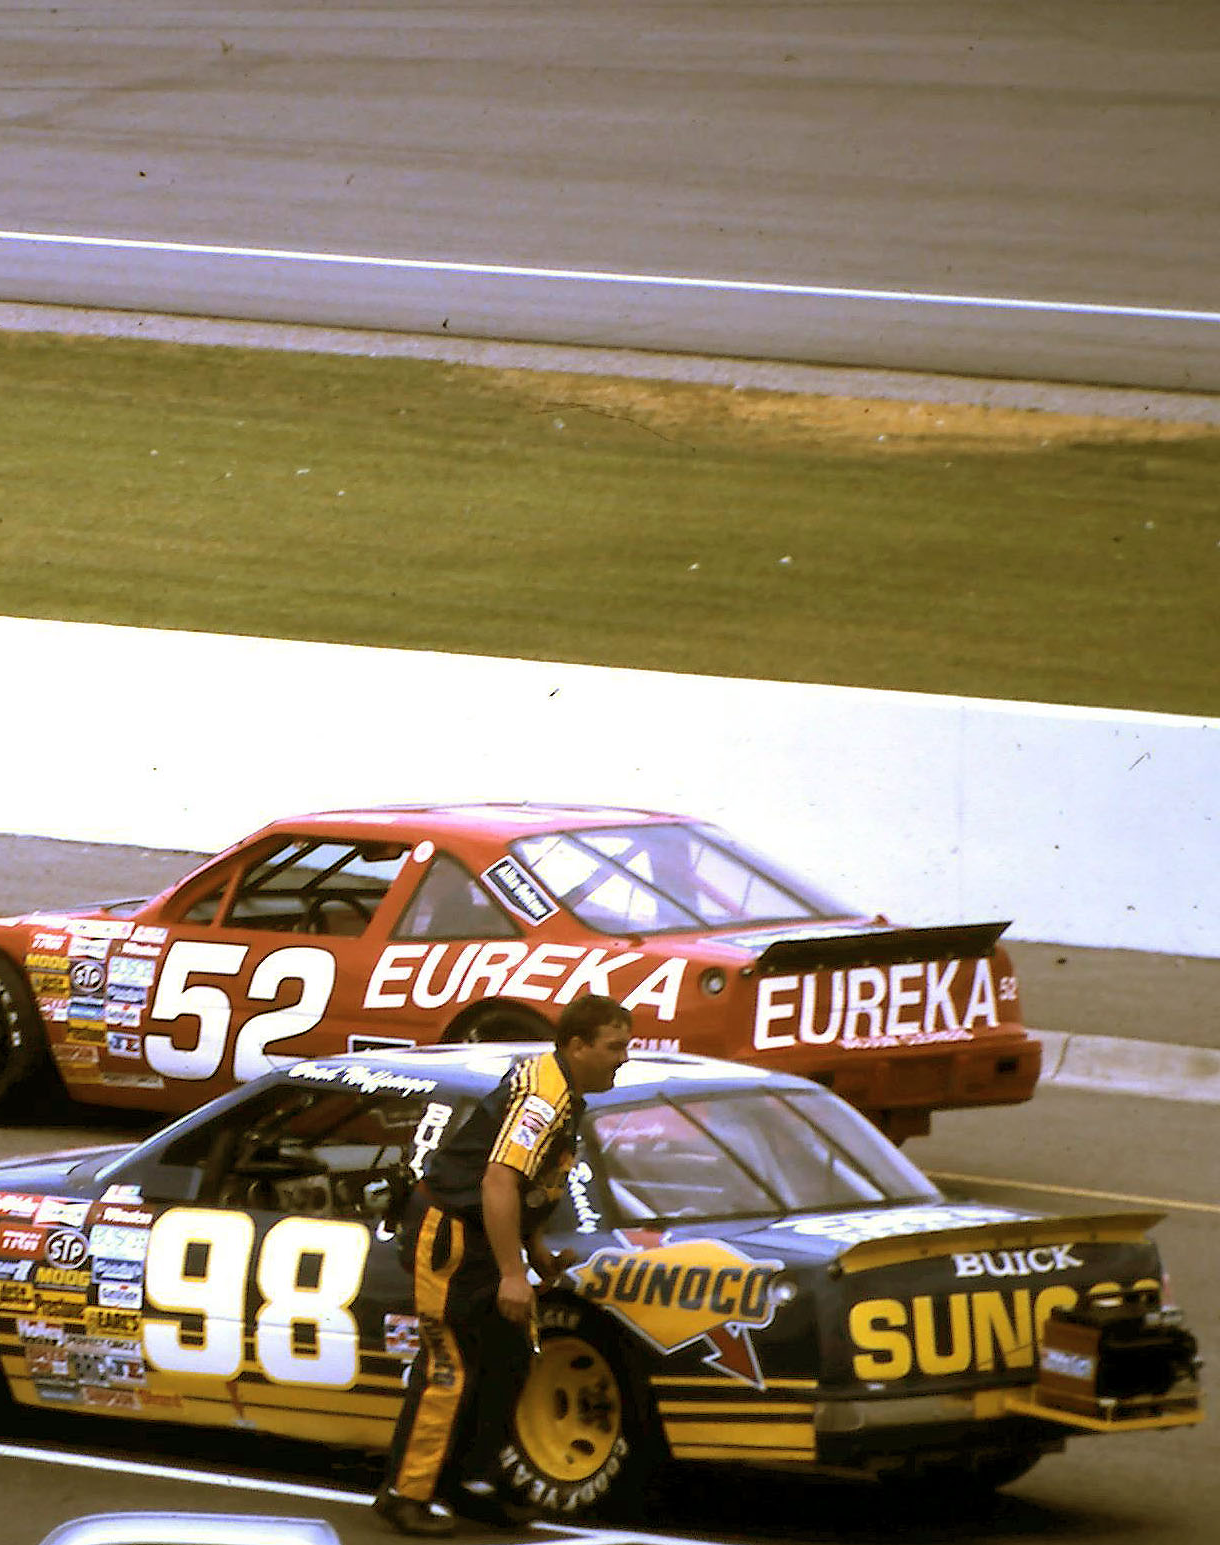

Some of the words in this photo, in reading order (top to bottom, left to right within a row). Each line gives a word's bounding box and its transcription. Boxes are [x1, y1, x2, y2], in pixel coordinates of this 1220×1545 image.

[143, 940, 336, 1085] 52
[363, 940, 688, 1022] EUREKA
[753, 957, 1001, 1051] EUREKA
[35, 1265, 92, 1287] MOOG
[49, 1234, 84, 1262] STP
[951, 1243, 1084, 1279] BUICK
[147, 1207, 371, 1391] 98
[584, 1254, 774, 1321] SUNOCO
